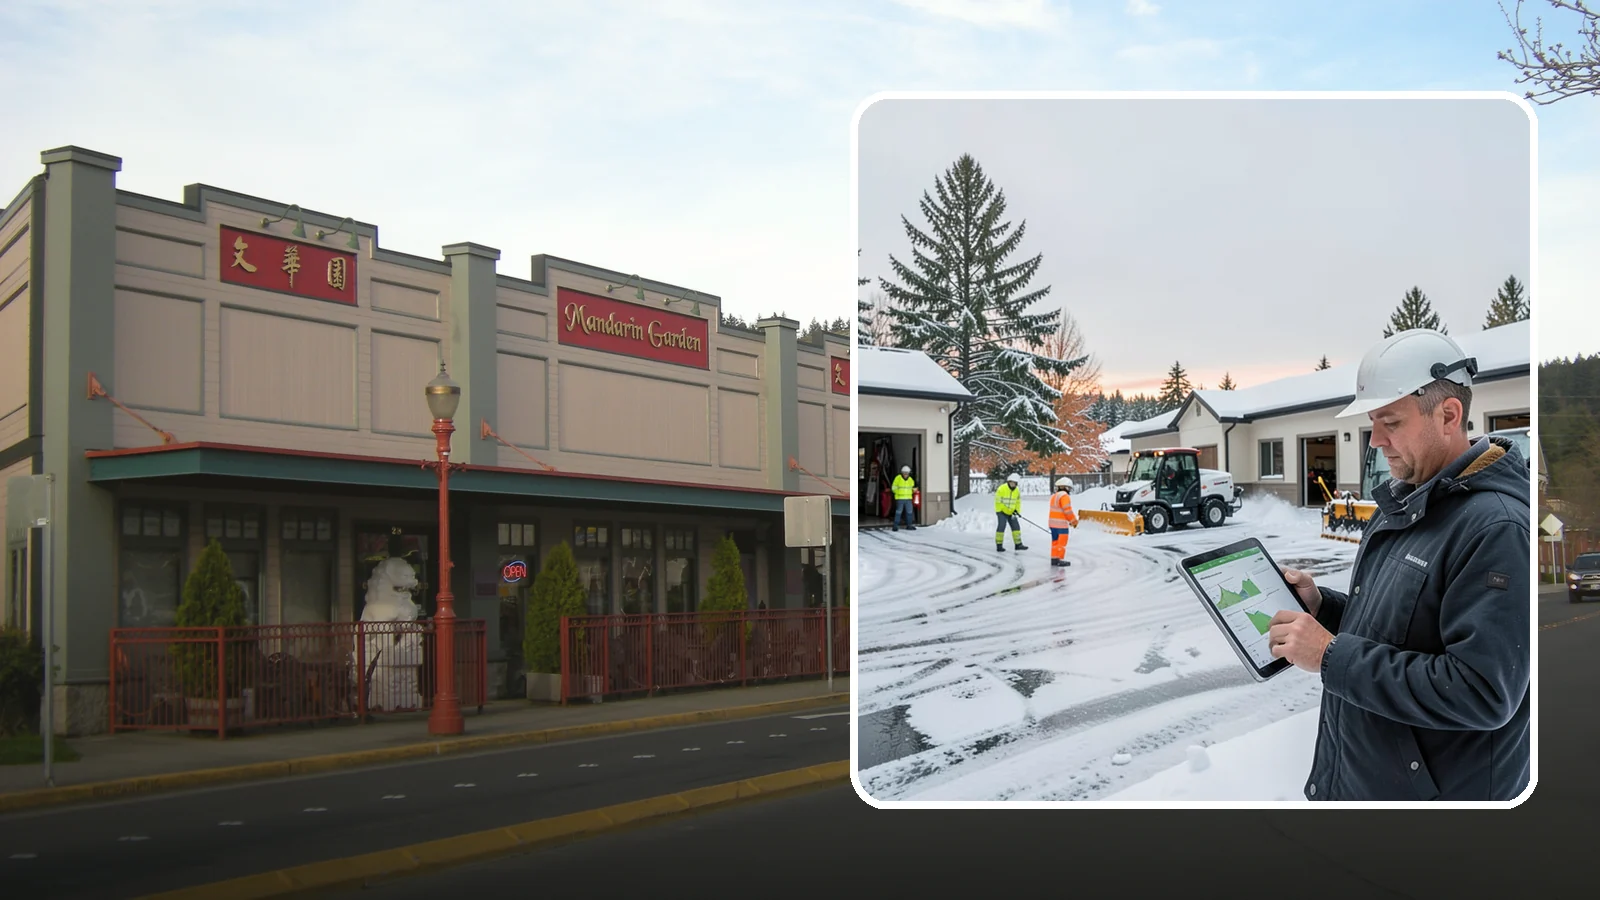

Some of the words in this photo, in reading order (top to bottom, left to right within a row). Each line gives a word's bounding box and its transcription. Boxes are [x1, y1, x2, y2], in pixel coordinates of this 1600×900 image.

[231, 235, 346, 290] 文華園
[564, 302, 644, 341] Mandarin
[648, 320, 701, 352] Garden
[835, 363, 846, 386] 文
[503, 565, 526, 578] OPEN
